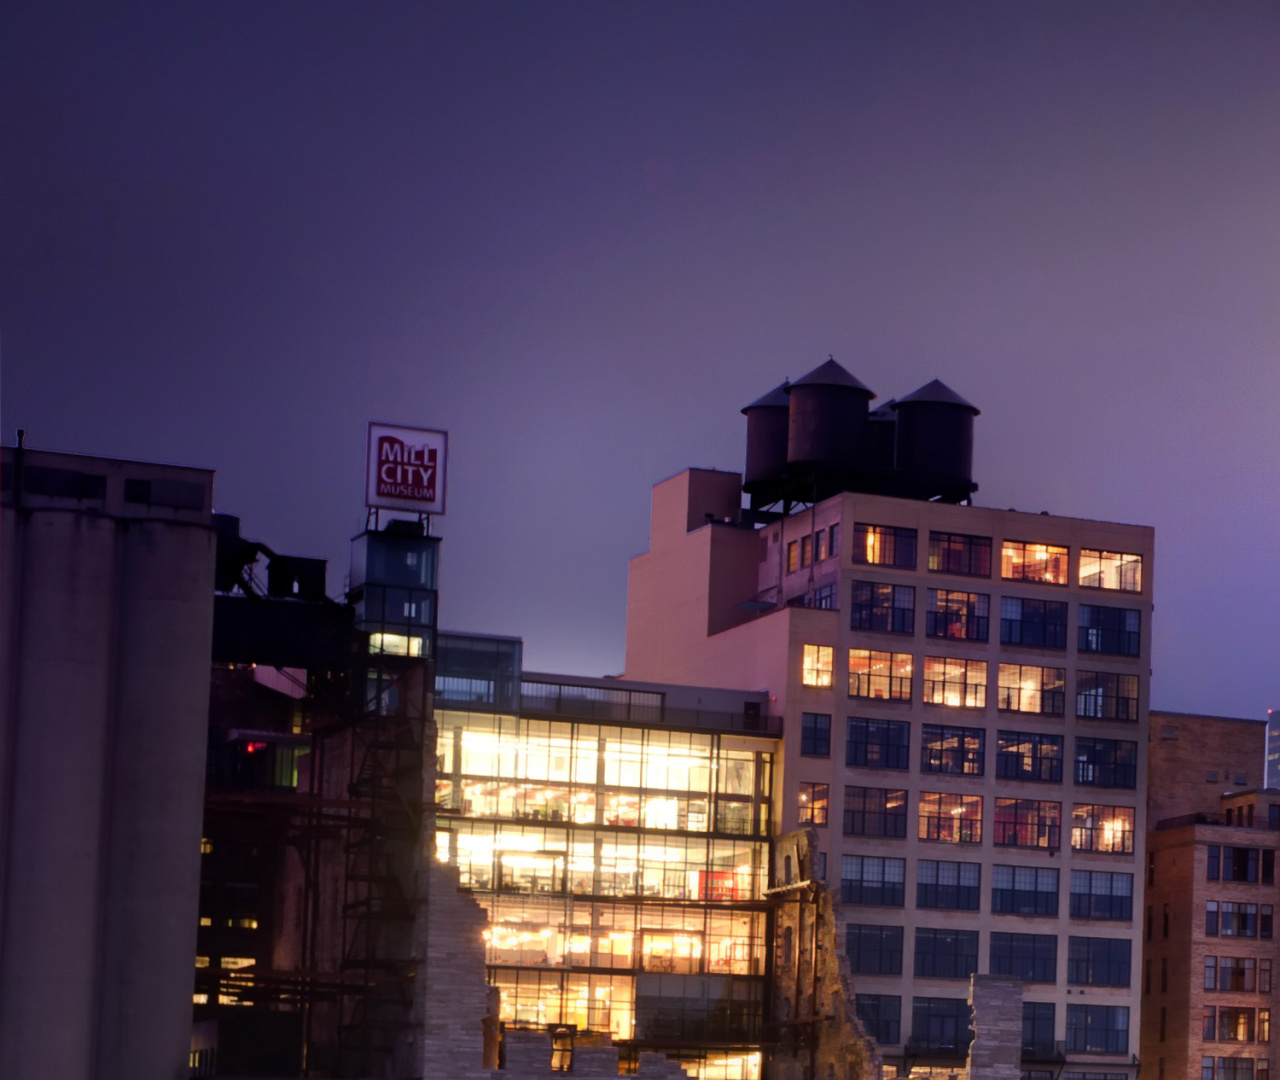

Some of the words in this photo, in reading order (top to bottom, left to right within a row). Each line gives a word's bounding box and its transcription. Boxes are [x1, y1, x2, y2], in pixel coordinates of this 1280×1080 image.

[381, 442, 435, 466] MILL
[381, 464, 434, 487] CITY
[380, 483, 434, 499] MUSEUM
